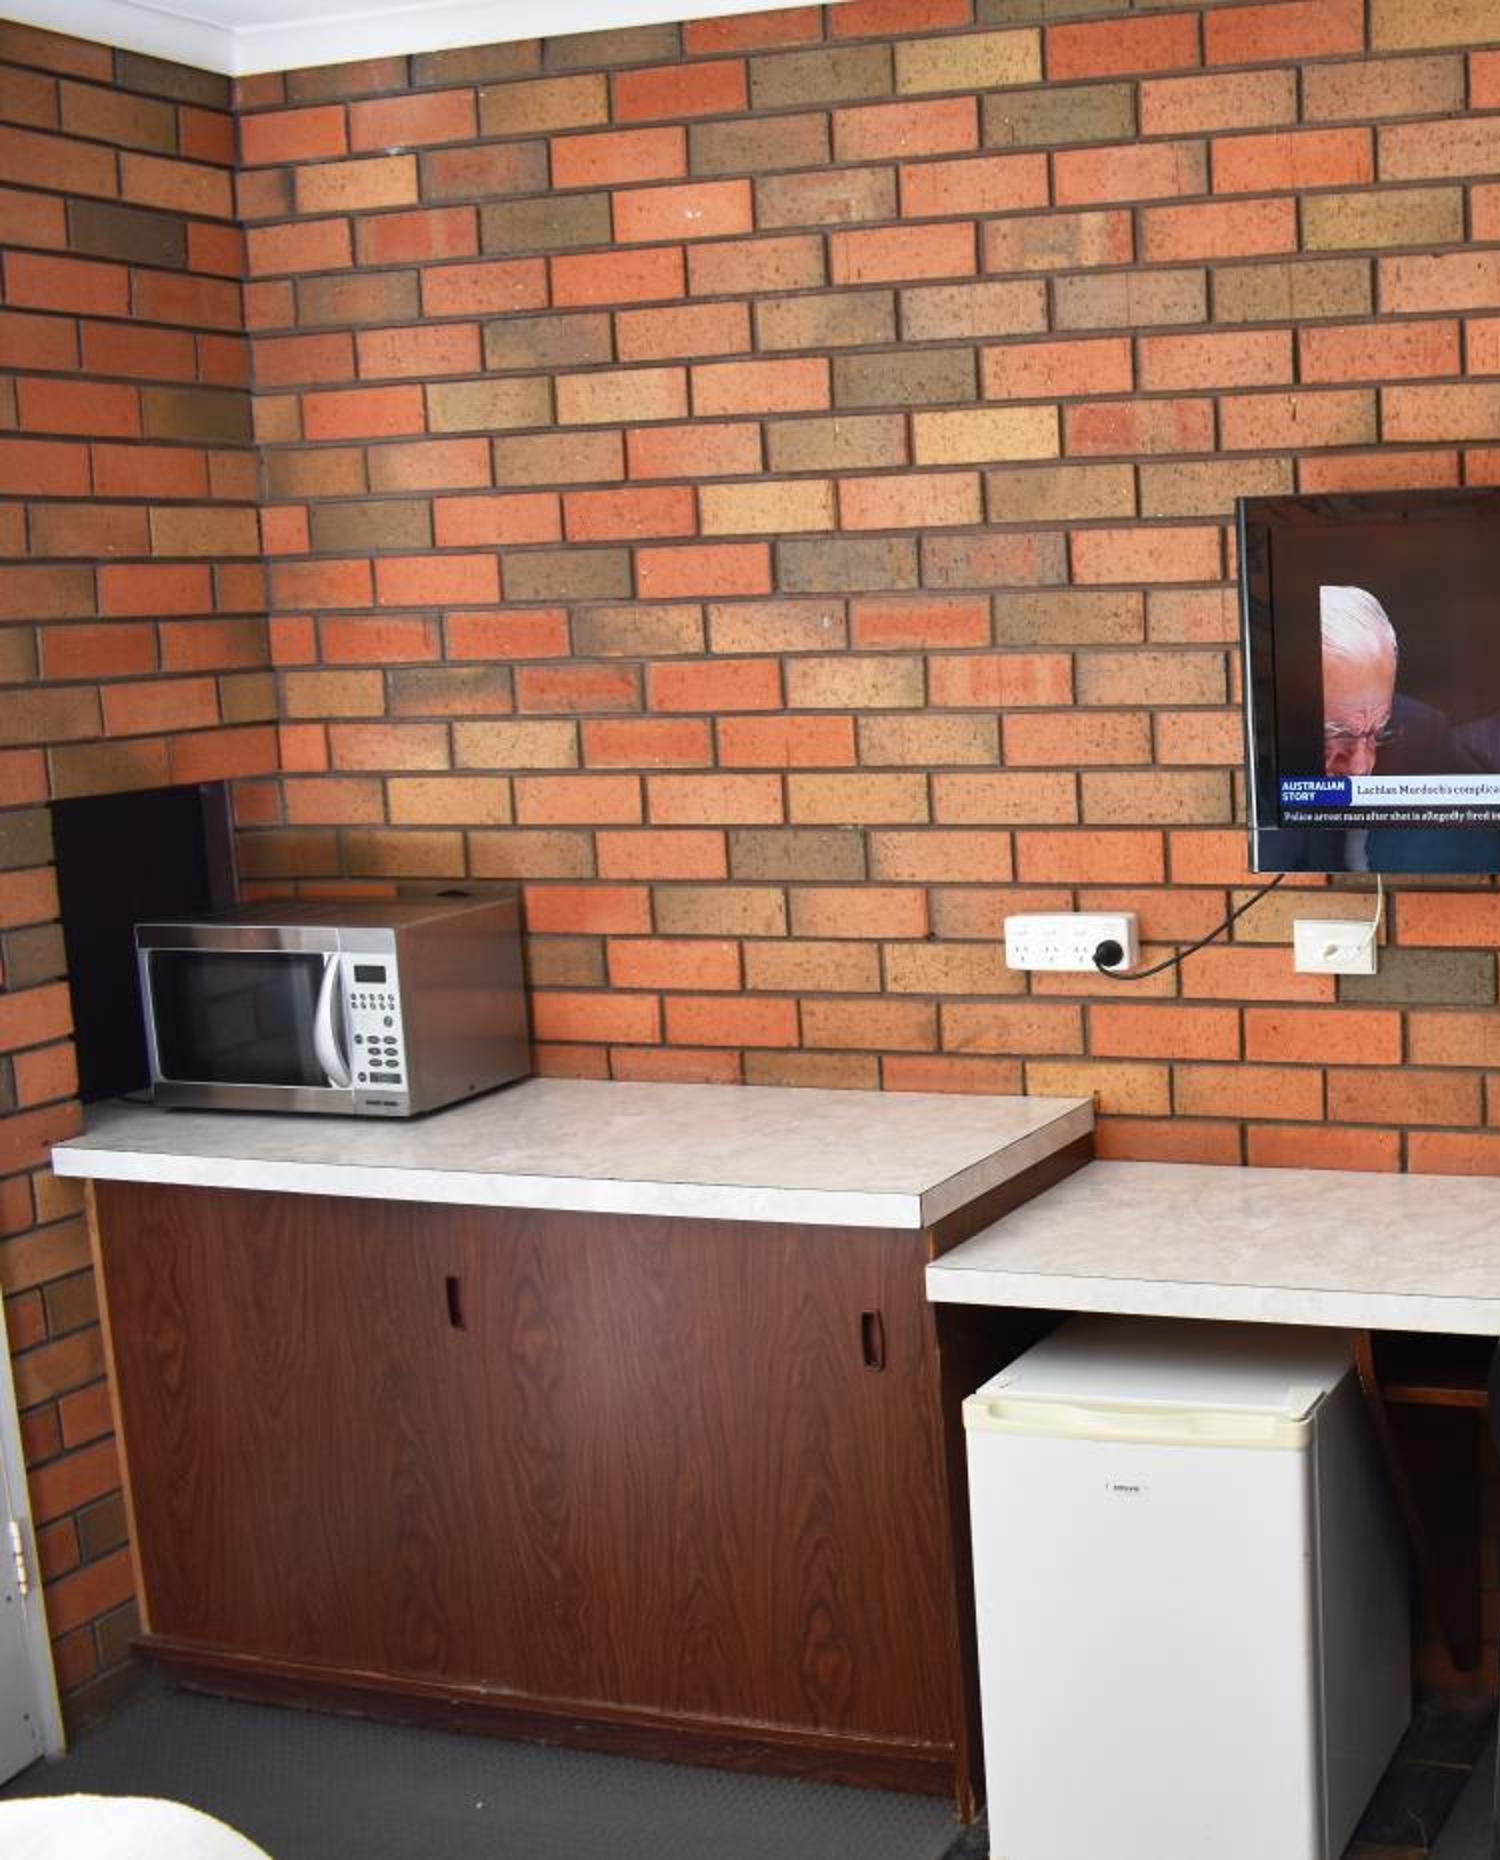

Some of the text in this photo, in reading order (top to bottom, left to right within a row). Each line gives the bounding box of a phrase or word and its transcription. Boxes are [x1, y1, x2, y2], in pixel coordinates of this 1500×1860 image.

[1281, 781, 1345, 791] AUSTRALIAN
[1357, 784, 1397, 795] Lachlan
[1281, 791, 1316, 801] STORY
[1283, 811, 1312, 820] Police
[1314, 811, 1342, 820] arrest
[1343, 812, 1364, 820] man
[1365, 811, 1388, 820] after
[1389, 811, 1409, 820] shot
[1421, 810, 1464, 823] allegedly
[1466, 810, 1490, 820] fired
